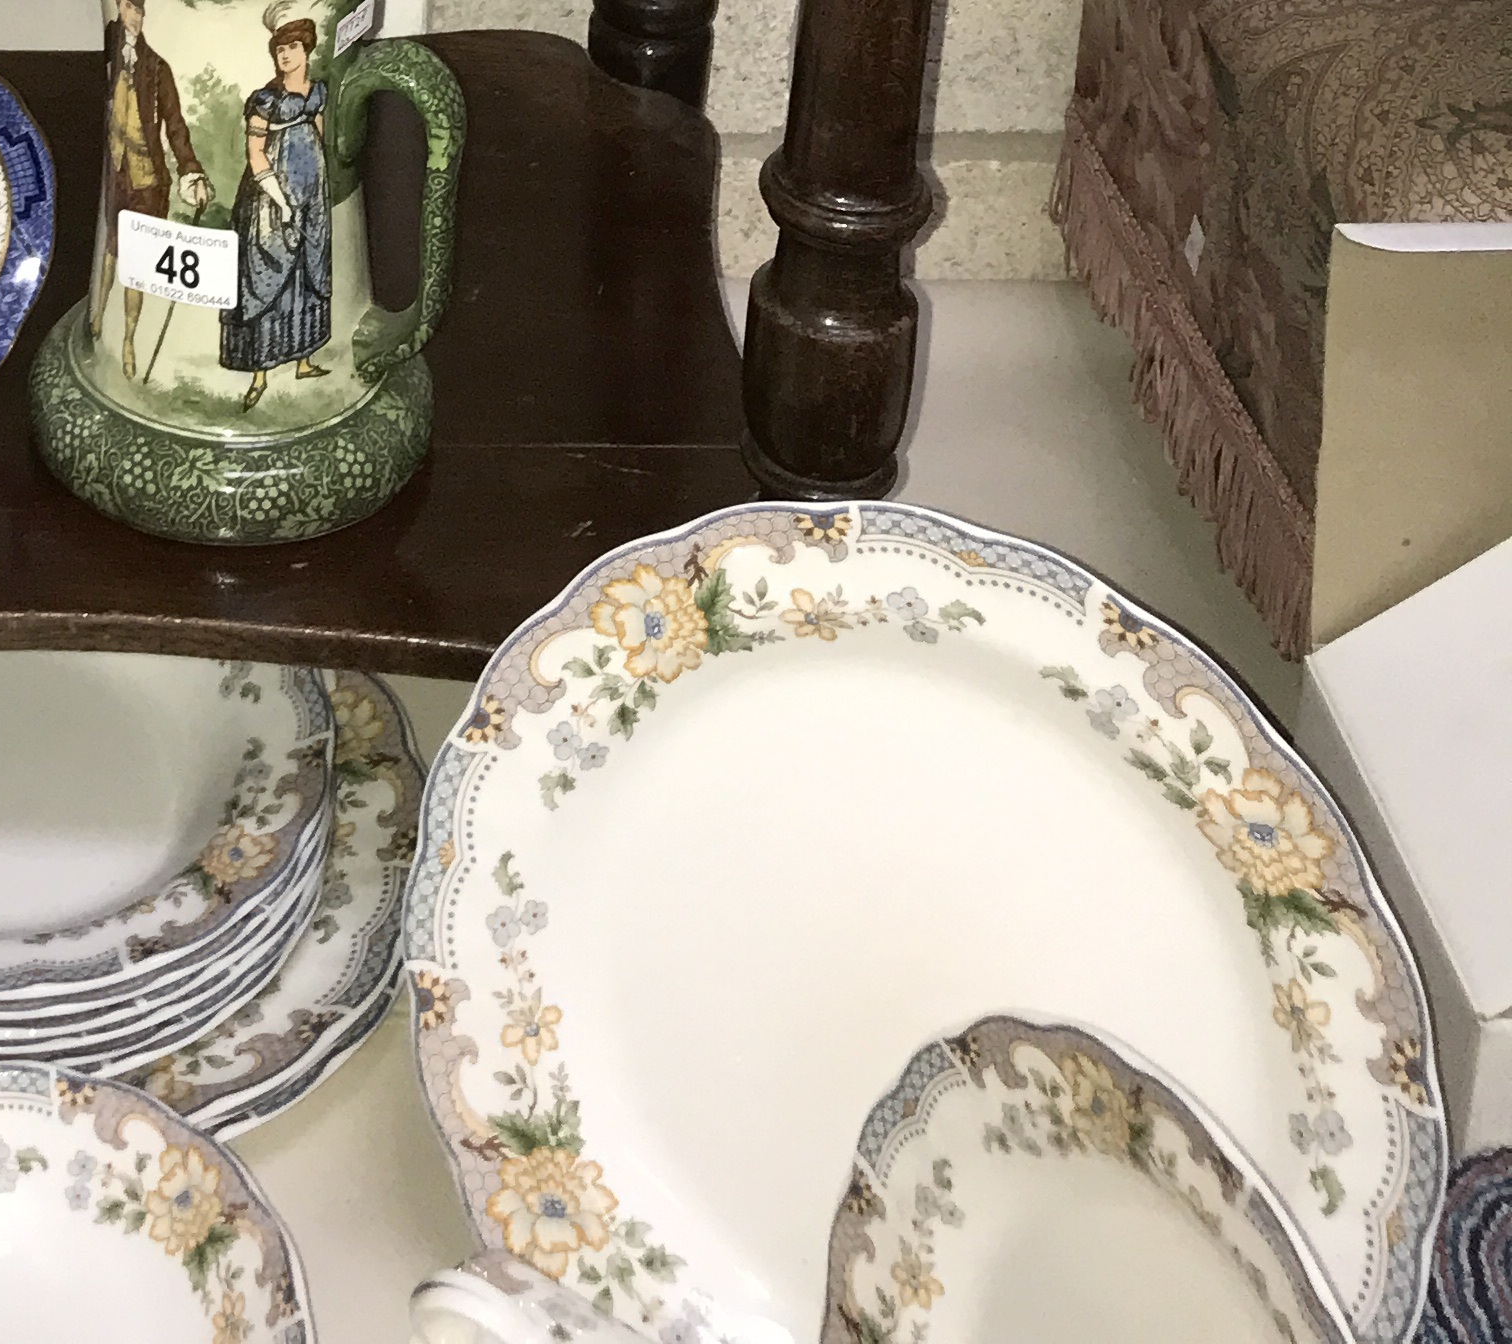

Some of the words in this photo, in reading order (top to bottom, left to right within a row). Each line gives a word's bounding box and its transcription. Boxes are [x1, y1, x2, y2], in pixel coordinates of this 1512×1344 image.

[131, 219, 172, 240] Unique
[175, 231, 228, 249] Auctions
[155, 245, 200, 289] 48
[150, 283, 184, 302] 01522
[187, 291, 231, 307] 690444
